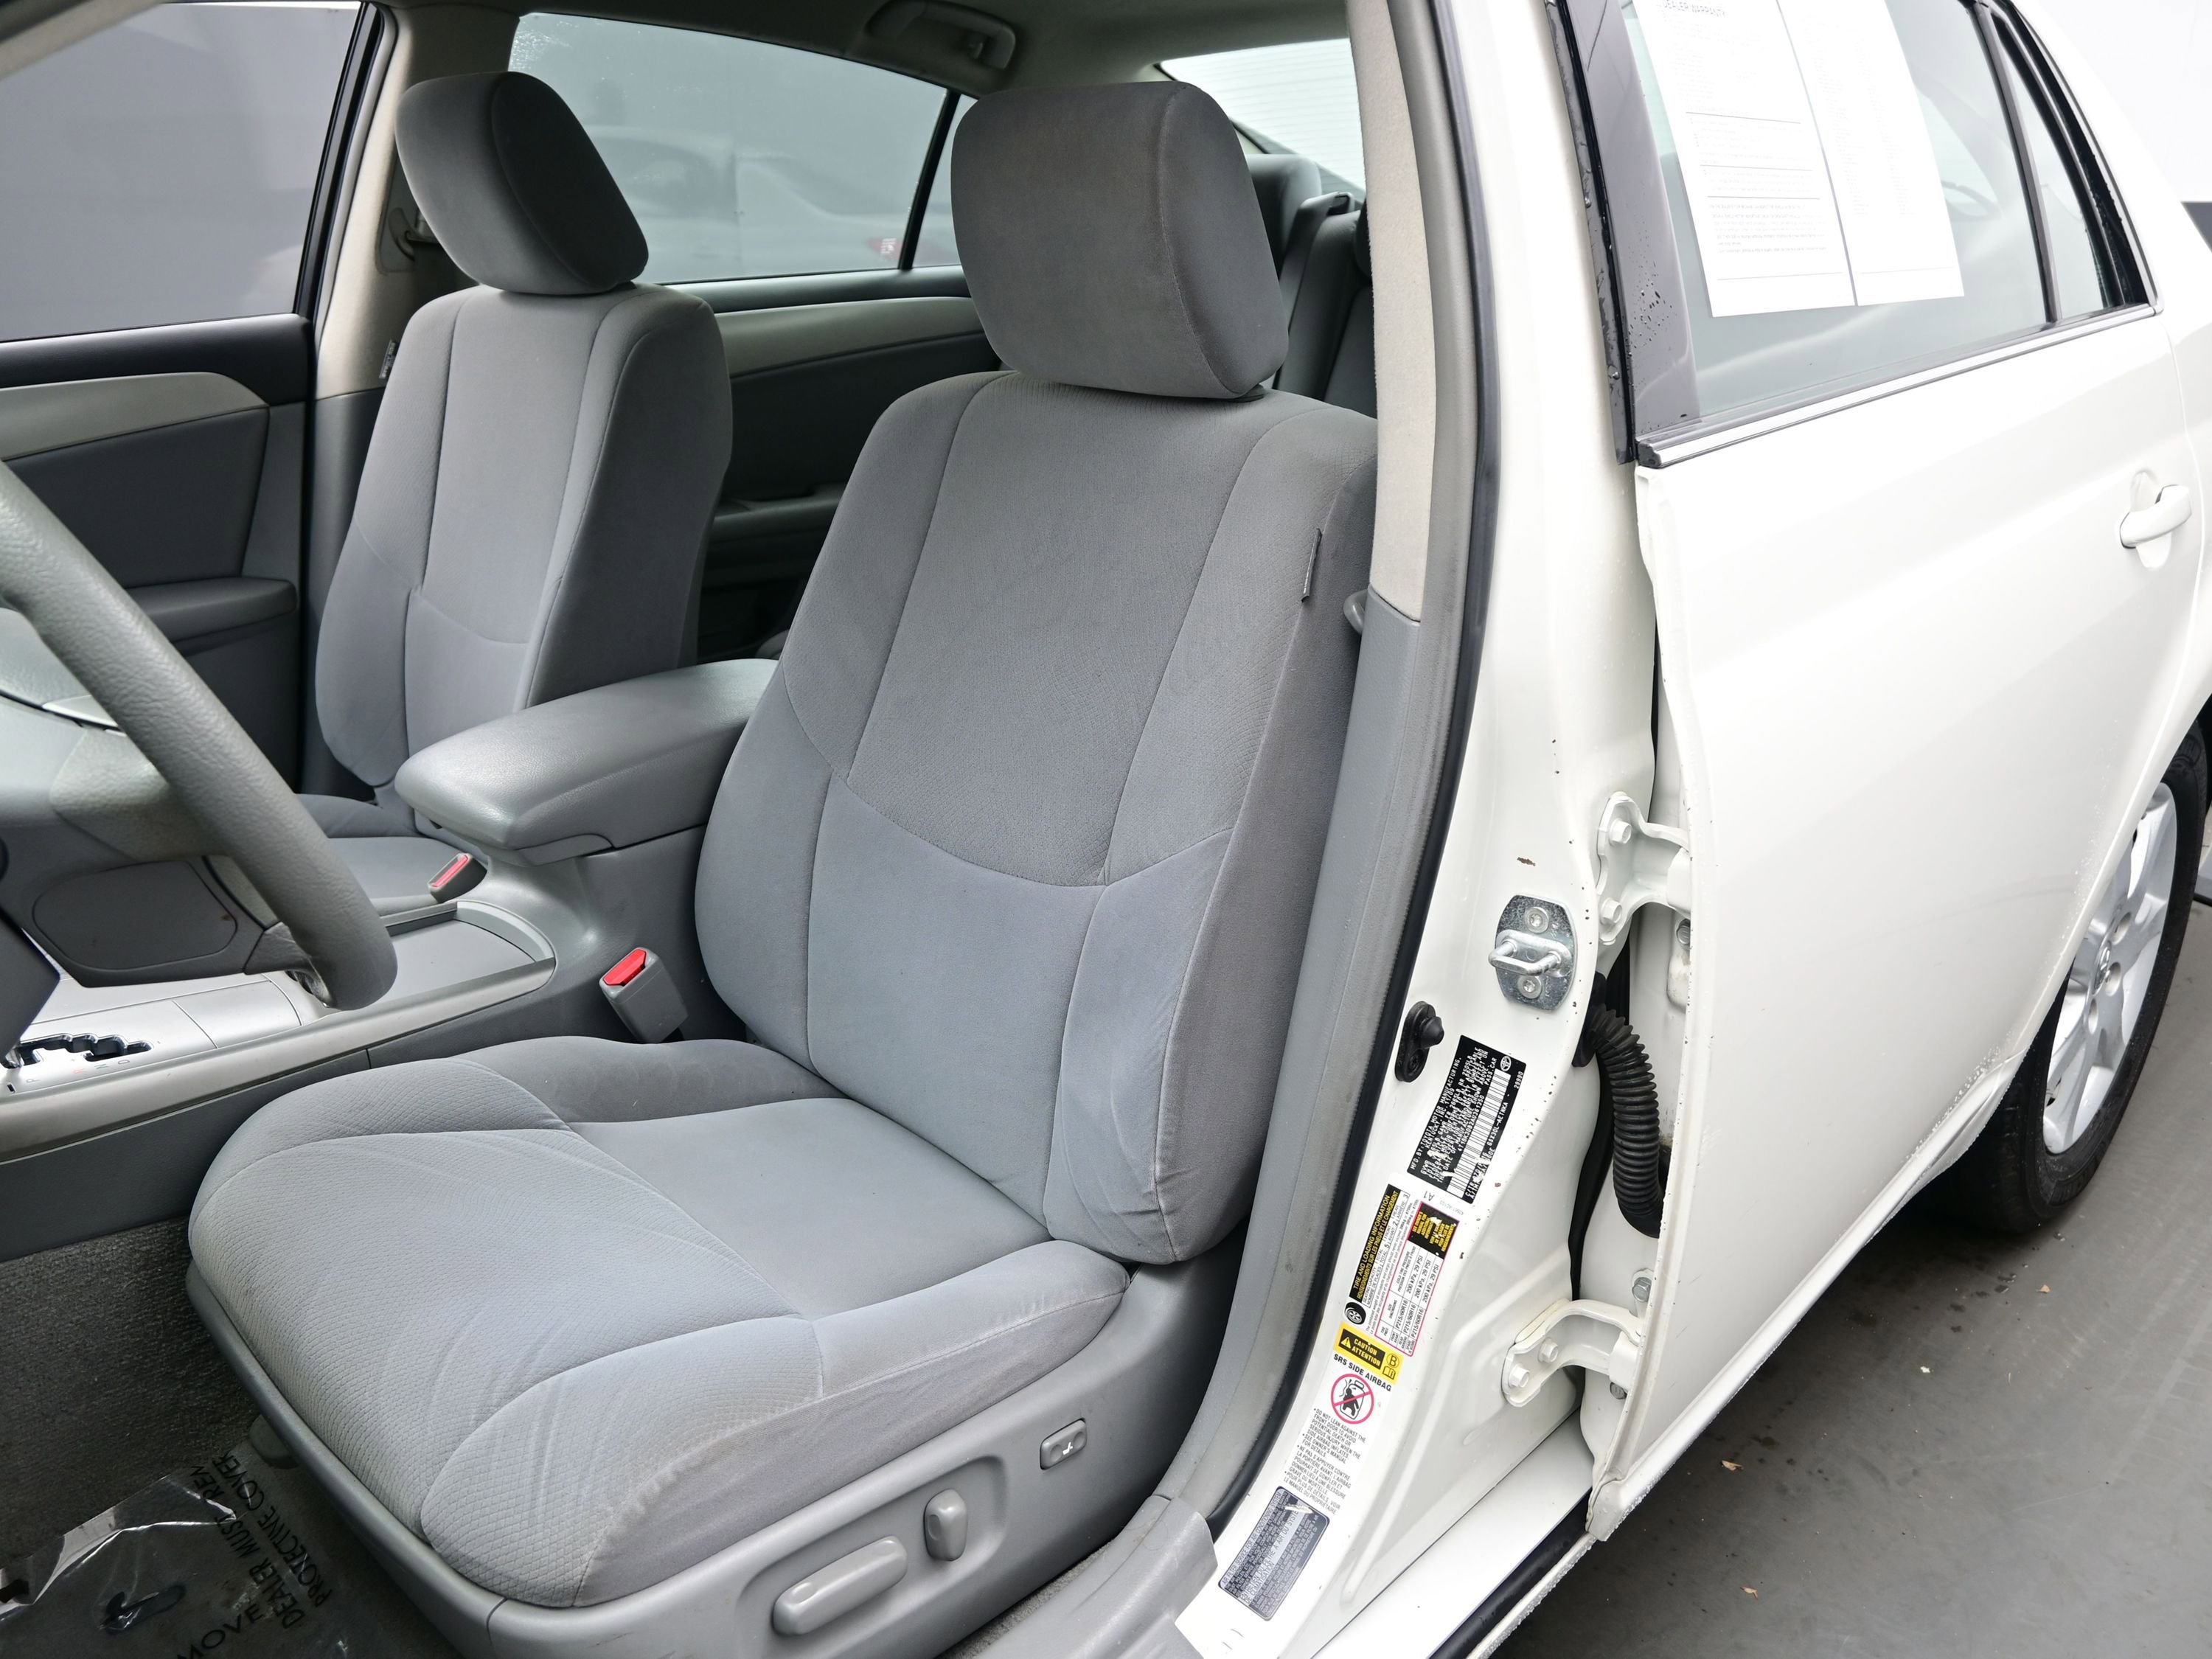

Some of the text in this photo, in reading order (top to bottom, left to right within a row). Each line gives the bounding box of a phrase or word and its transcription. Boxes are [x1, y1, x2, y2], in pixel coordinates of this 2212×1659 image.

[1430, 1105, 1442, 1124] MOTOR
[1352, 1194, 1390, 1290] TIRE AND LOADING INFORMATION
[1374, 1231, 1382, 1246] PNEUS
[1421, 1268, 1427, 1276] 29
[1429, 1273, 1436, 1281] 29
[1351, 1345, 1381, 1366] ATTENTION
[1353, 1338, 1378, 1356] CAUTION
[1332, 1352, 1393, 1392] SRS SIDE AIRBAG
[1388, 1354, 1398, 1368] B
[1306, 1428, 1316, 1438] SIDE
[1315, 1434, 1331, 1447] AIRBAG
[1311, 1418, 1332, 1435] POTENTIAL
[1332, 1431, 1345, 1443] DEATH
[1313, 1413, 1327, 1425] FRONT
[1326, 1421, 1338, 1432] DOOR
[1343, 1432, 1357, 1443] AVOID
[1315, 1408, 1366, 1442] DO NOT LEAN AGAINST THE
[1301, 1439, 1311, 1447] FOR
[1304, 1433, 1312, 1441] SEE
[1329, 1450, 1346, 1464] MANUAL
[1309, 1423, 1360, 1459] SERIOUS INJURY WHEN THE
[1304, 1449, 1313, 1457] PAS
[1333, 1467, 1350, 1481] CONTRE
[257, 1506, 332, 1607] PROTECTIVE
[249, 1557, 305, 1629] DEALER
